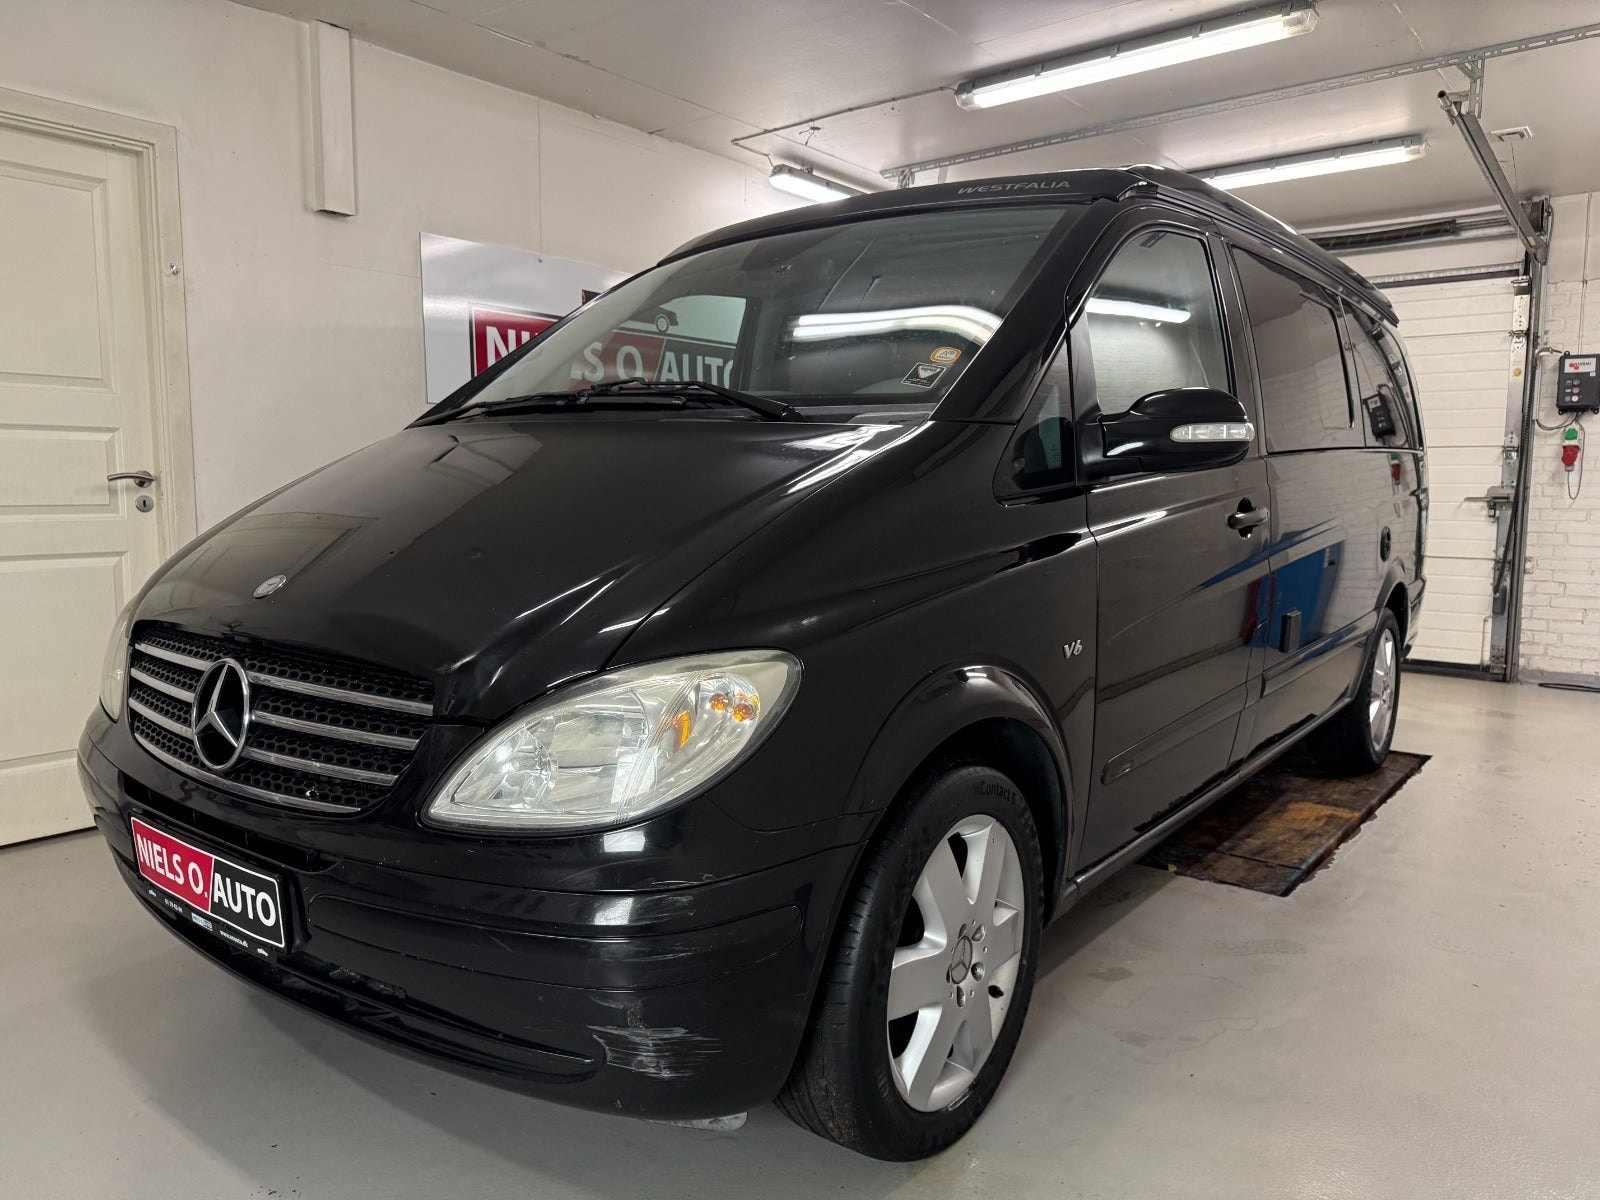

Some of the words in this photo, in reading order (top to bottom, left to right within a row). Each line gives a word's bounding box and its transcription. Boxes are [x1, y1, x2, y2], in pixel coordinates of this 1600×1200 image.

[957, 181, 1071, 195] WESTFALIA
[1063, 639, 1083, 659] V6
[136, 833, 185, 885] NIELS
[188, 861, 208, 899] O.
[213, 872, 276, 927] AUTO
